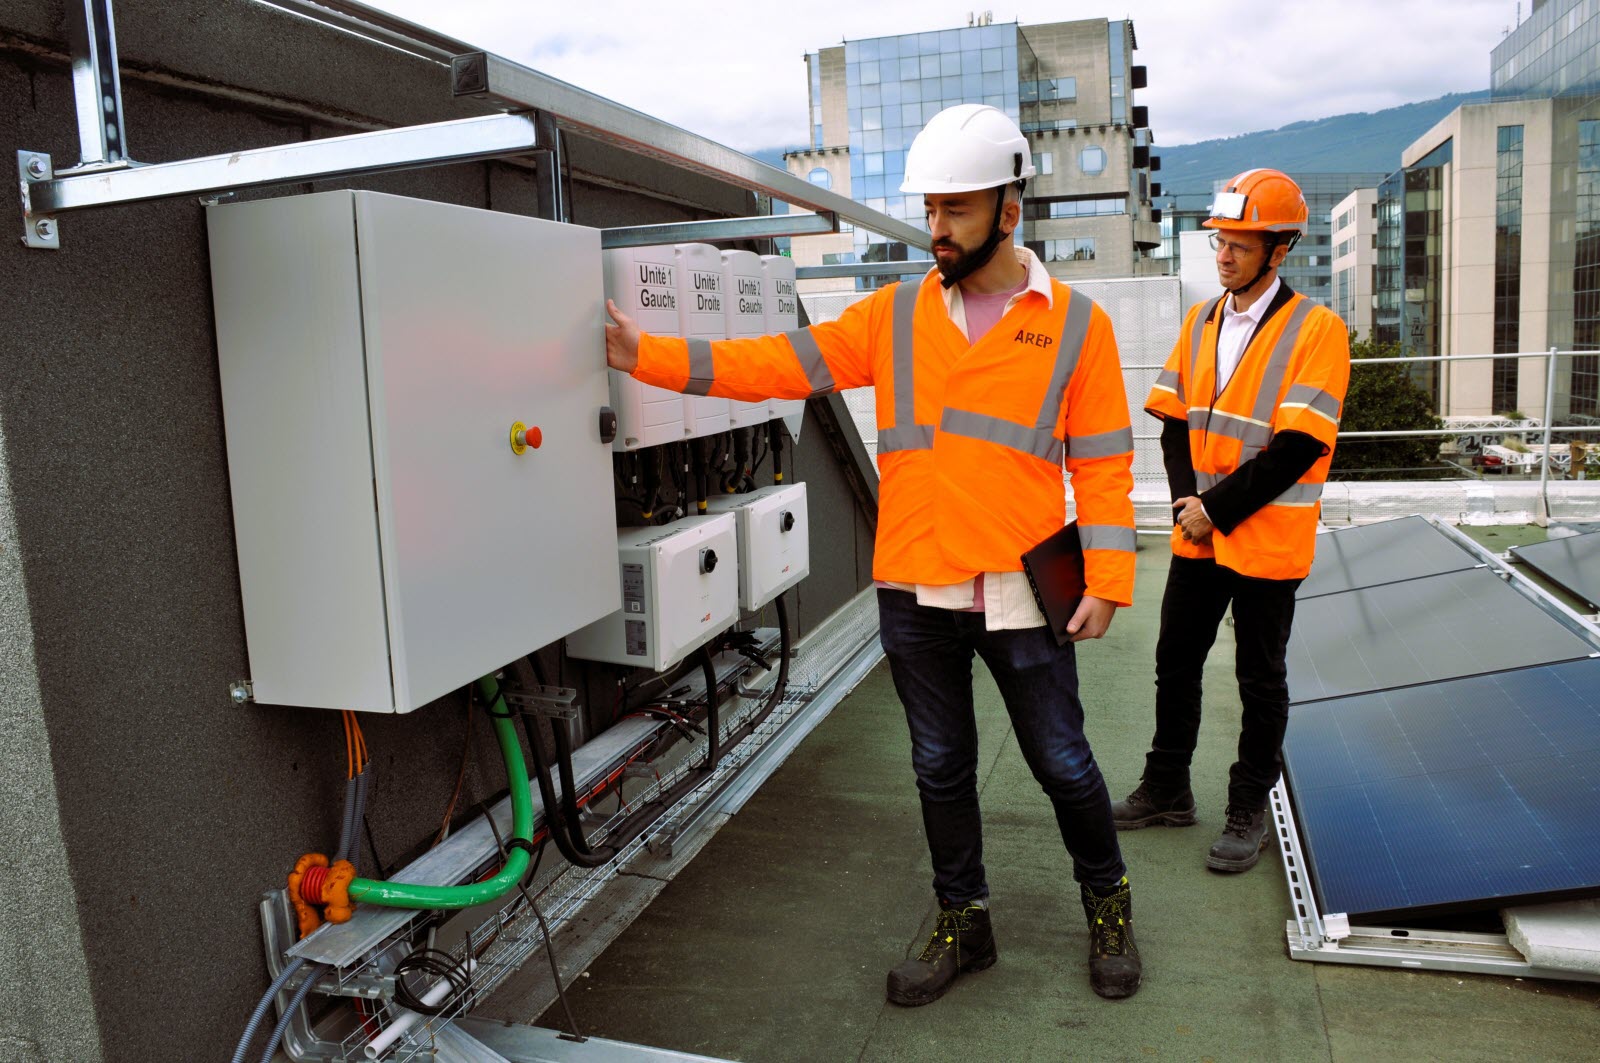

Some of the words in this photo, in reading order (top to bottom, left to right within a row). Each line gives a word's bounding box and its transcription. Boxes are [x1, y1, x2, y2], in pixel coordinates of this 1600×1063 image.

[640, 265, 666, 285] Unité
[694, 273, 715, 290] Unité
[738, 279, 757, 295] Unité
[776, 280, 792, 295] Unité
[640, 289, 675, 308] Gauche
[697, 294, 720, 311] Droite
[739, 298, 762, 313] Gauche
[778, 299, 796, 313] Droite
[1014, 329, 1053, 348] AREP
